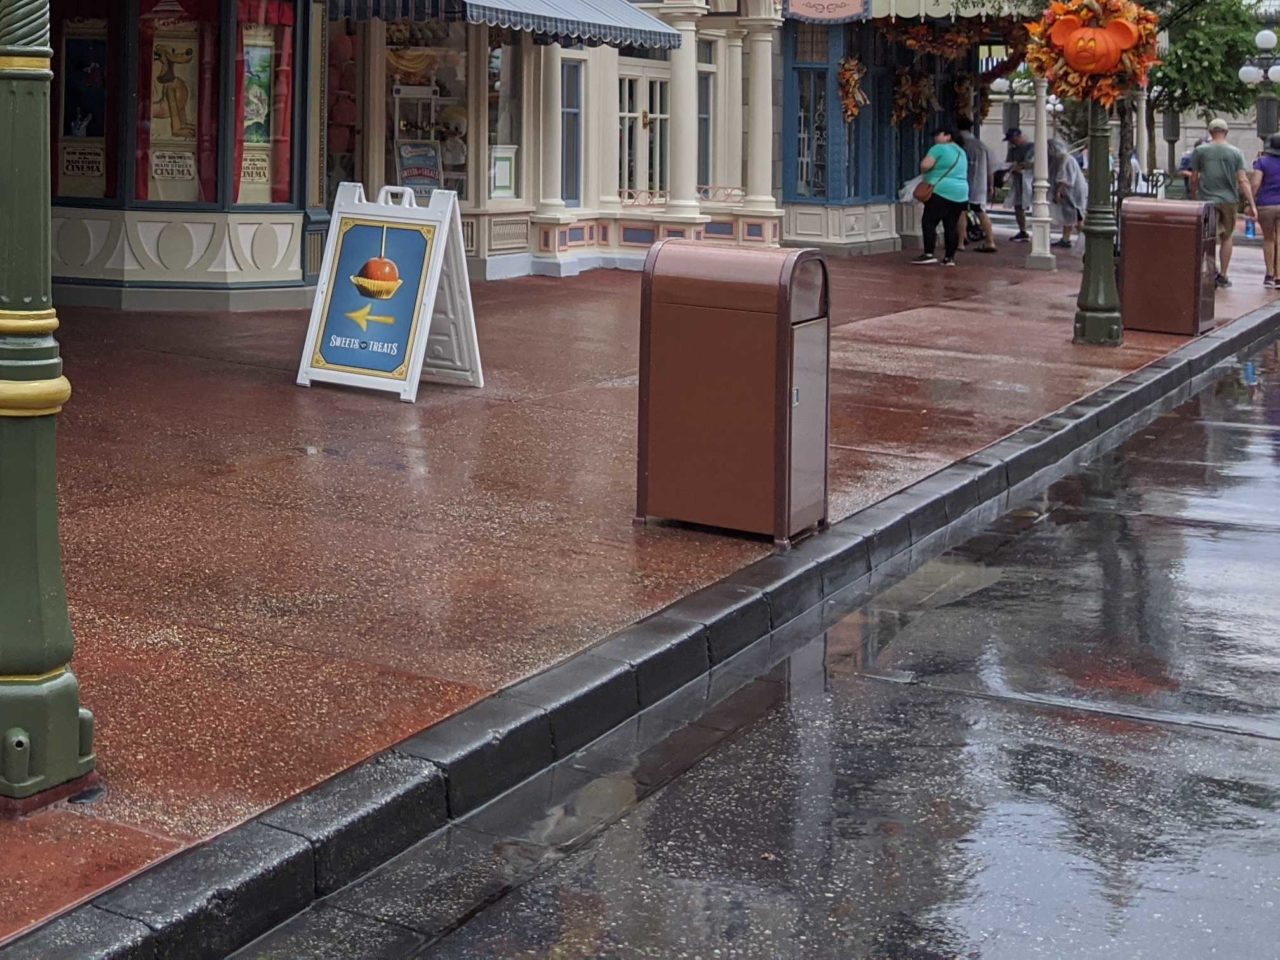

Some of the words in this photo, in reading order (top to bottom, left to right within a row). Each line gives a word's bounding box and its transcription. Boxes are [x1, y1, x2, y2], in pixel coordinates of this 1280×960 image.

[65, 164, 101, 172] CINEMA
[154, 168, 192, 176] CINEMA
[329, 334, 360, 349] SWEETS
[368, 341, 398, 355] TREATS
